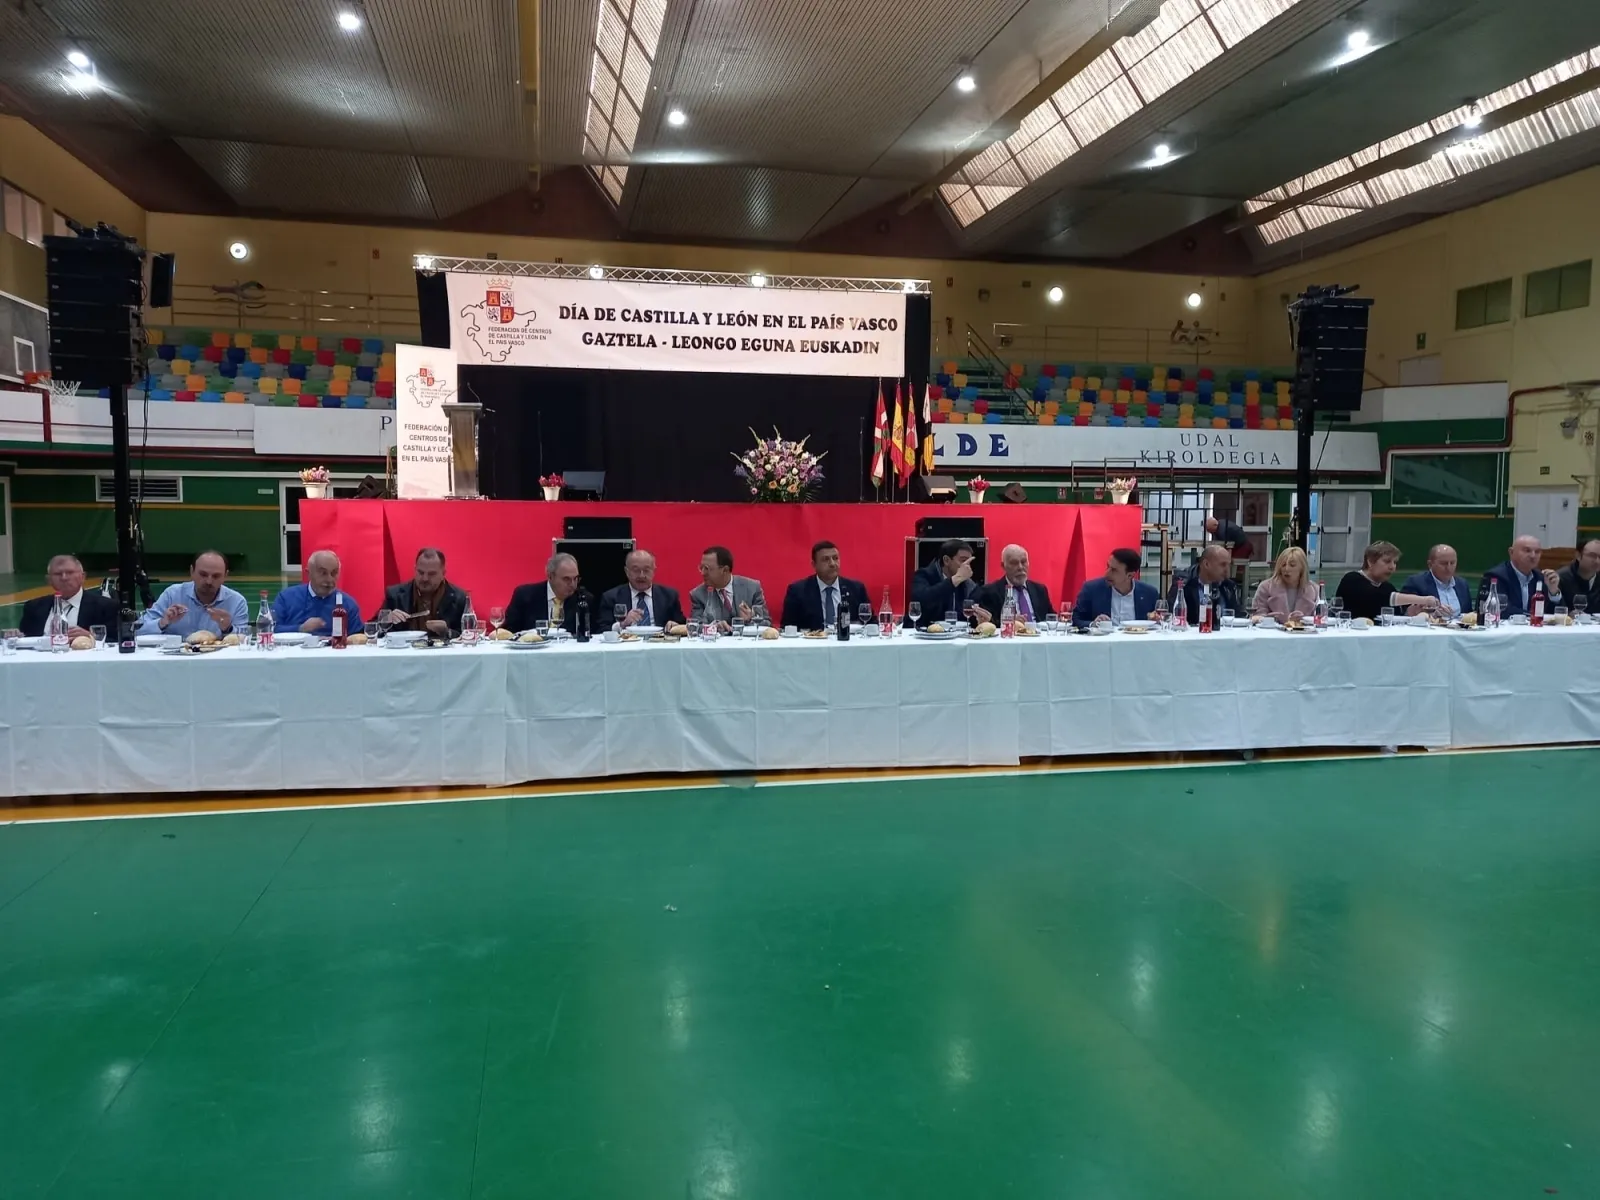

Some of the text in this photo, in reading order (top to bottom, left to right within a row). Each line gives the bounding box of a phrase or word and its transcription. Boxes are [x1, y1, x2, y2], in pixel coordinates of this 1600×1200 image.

[559, 303, 898, 331] DÍA DE CASTILLA Y LEÓN EN EL PAÍS VASCO
[582, 332, 657, 347] GAZTELA
[672, 335, 737, 351] LEONGO
[741, 338, 795, 352] EGUNA
[800, 339, 880, 354] EUSKADIN
[404, 423, 443, 432] FEDERACIÓN
[409, 434, 438, 442] CENTROS
[1180, 433, 1240, 447] UDAL
[1140, 450, 1281, 465] KIROLDEGIA
